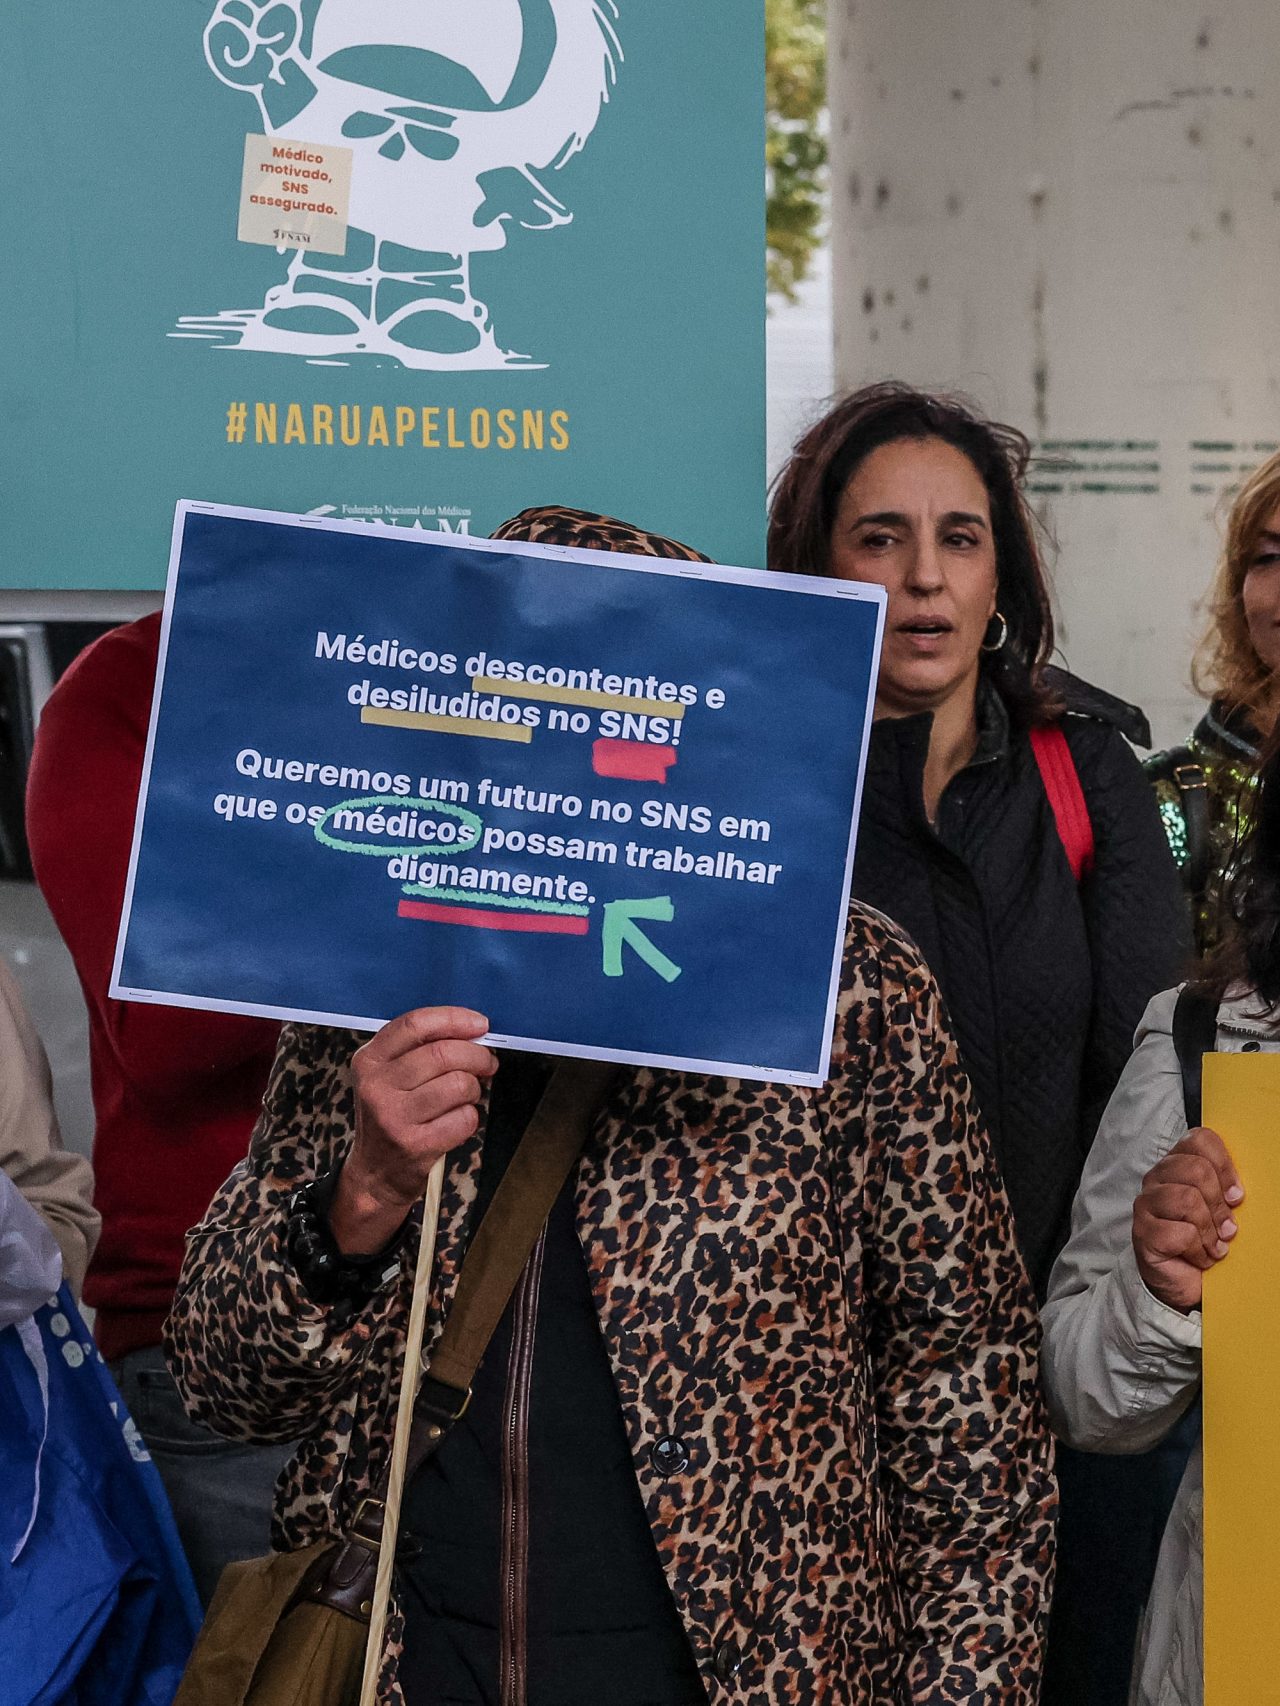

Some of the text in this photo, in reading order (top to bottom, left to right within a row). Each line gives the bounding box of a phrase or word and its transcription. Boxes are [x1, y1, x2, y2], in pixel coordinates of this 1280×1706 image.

[260, 162, 333, 183] motivado,
[272, 146, 323, 164] Médico
[250, 194, 338, 215] assegurado.
[282, 181, 309, 194] SNS
[226, 402, 570, 450] #NARUAPELOSNS
[385, 504, 420, 515] Nacional
[315, 631, 726, 709] Médicos descontentes e
[347, 679, 682, 746] desiludidos no SNS!
[236, 748, 771, 842] Queremos um futuro no SNS em
[213, 793, 783, 885] que os médicos possam trabalhar
[387, 854, 596, 904] dignamente.
